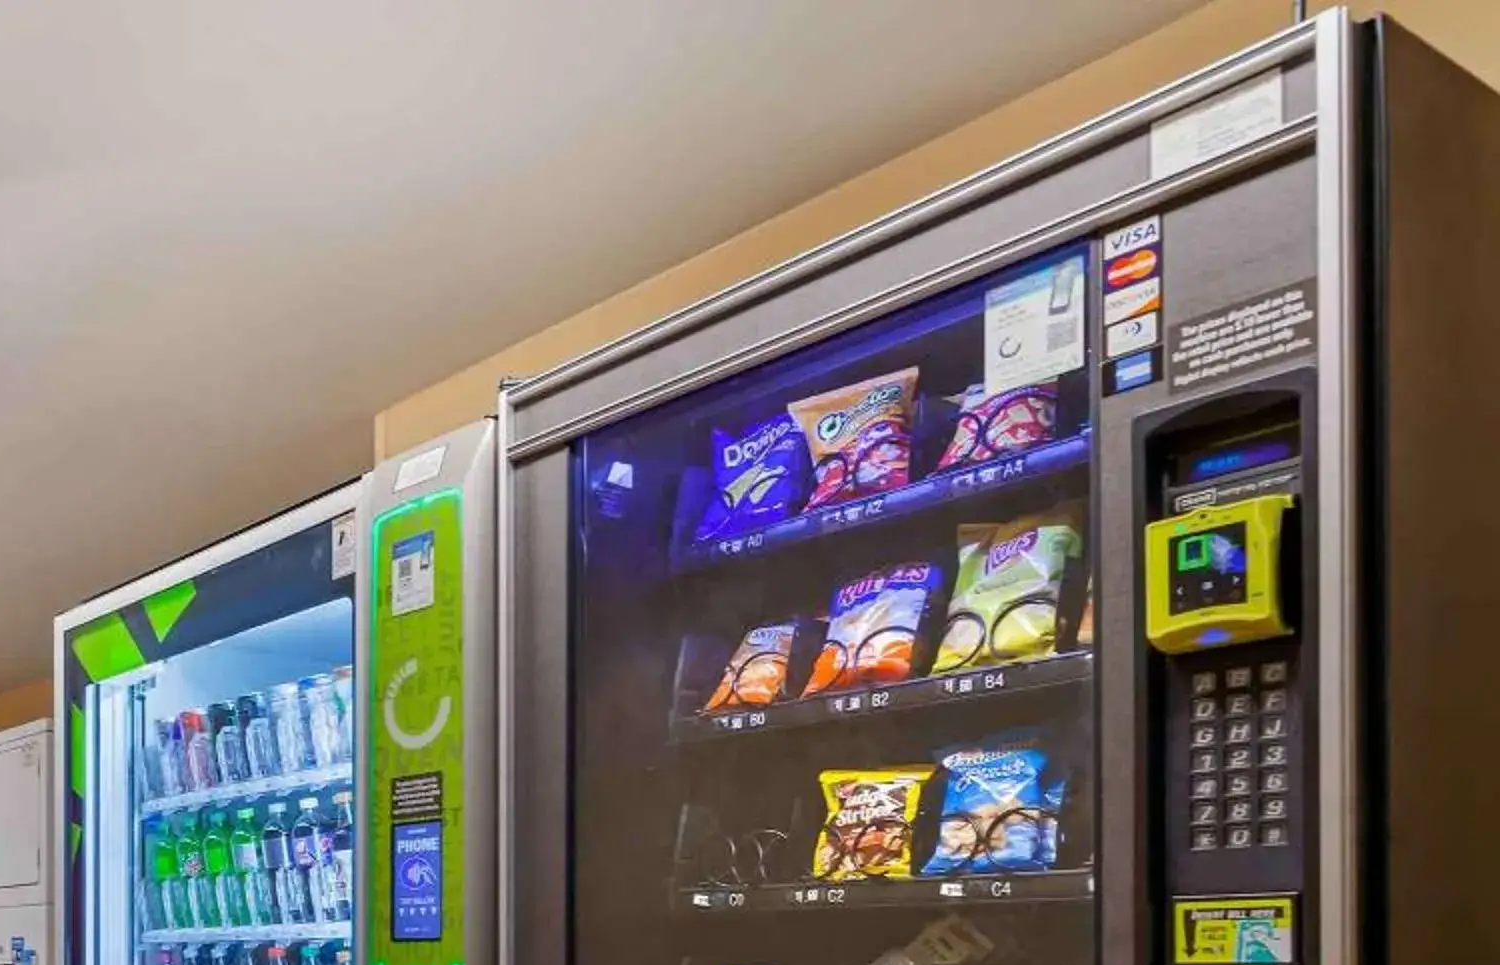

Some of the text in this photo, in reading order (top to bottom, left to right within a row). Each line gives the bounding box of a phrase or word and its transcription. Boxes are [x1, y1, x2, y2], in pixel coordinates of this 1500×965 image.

[1111, 223, 1157, 249] VISA
[1004, 460, 1026, 479] A4
[866, 499, 885, 516] A2
[748, 534, 764, 549] A0
[985, 673, 1005, 689] B4
[872, 692, 889, 708] B2
[1197, 693, 1281, 717] D E F
[749, 713, 765, 727] B0
[1197, 719, 1281, 744] G H J
[1200, 747, 1284, 771] 1 2 3
[1231, 777, 1246, 794] 5
[1267, 774, 1283, 790] 6
[1200, 800, 1284, 822] 7 8 9
[397, 837, 440, 854] PHONE
[827, 889, 845, 904] C2
[991, 881, 1013, 898] C4
